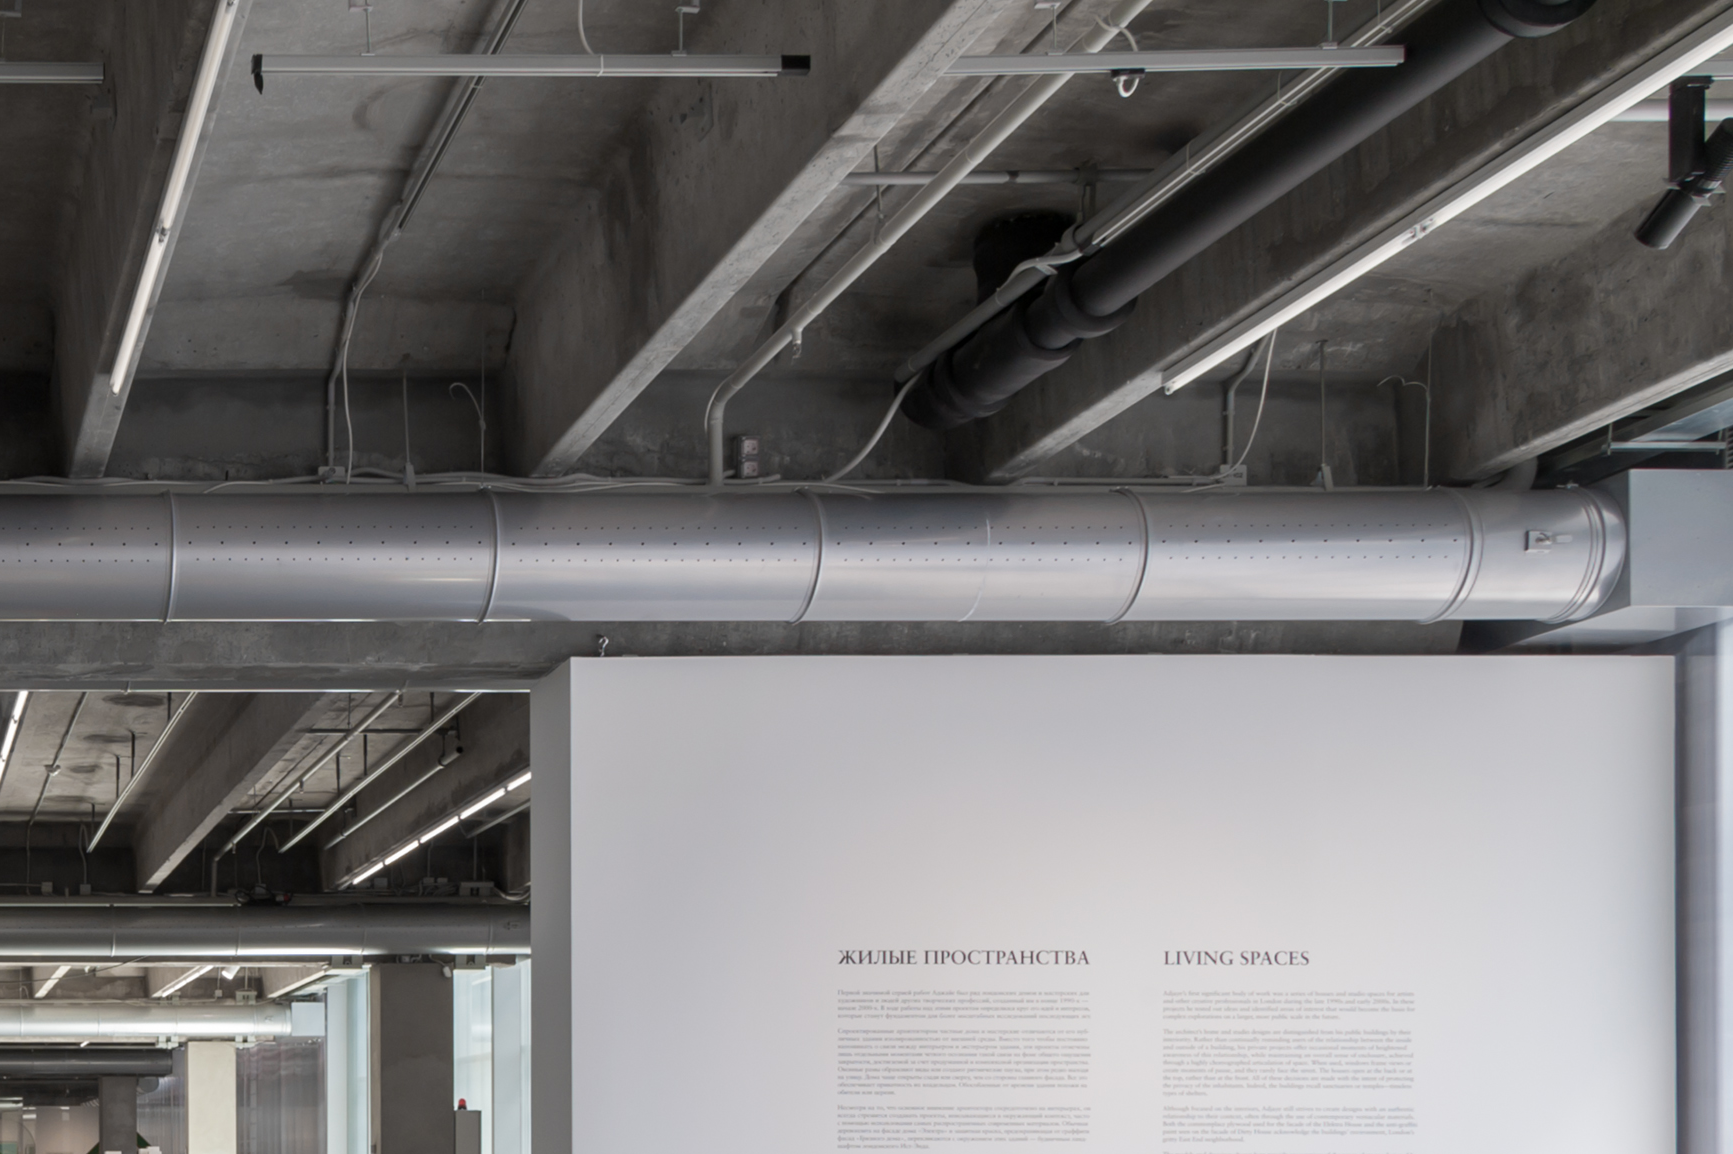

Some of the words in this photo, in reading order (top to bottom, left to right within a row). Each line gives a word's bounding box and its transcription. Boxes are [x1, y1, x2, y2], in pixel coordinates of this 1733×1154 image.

[838, 949, 917, 965] ЖИЛЫЕ
[924, 949, 1090, 965] ПРОСТРАНСТВА
[1164, 950, 1234, 966] LIVING
[1239, 950, 1310, 966] SPACES
